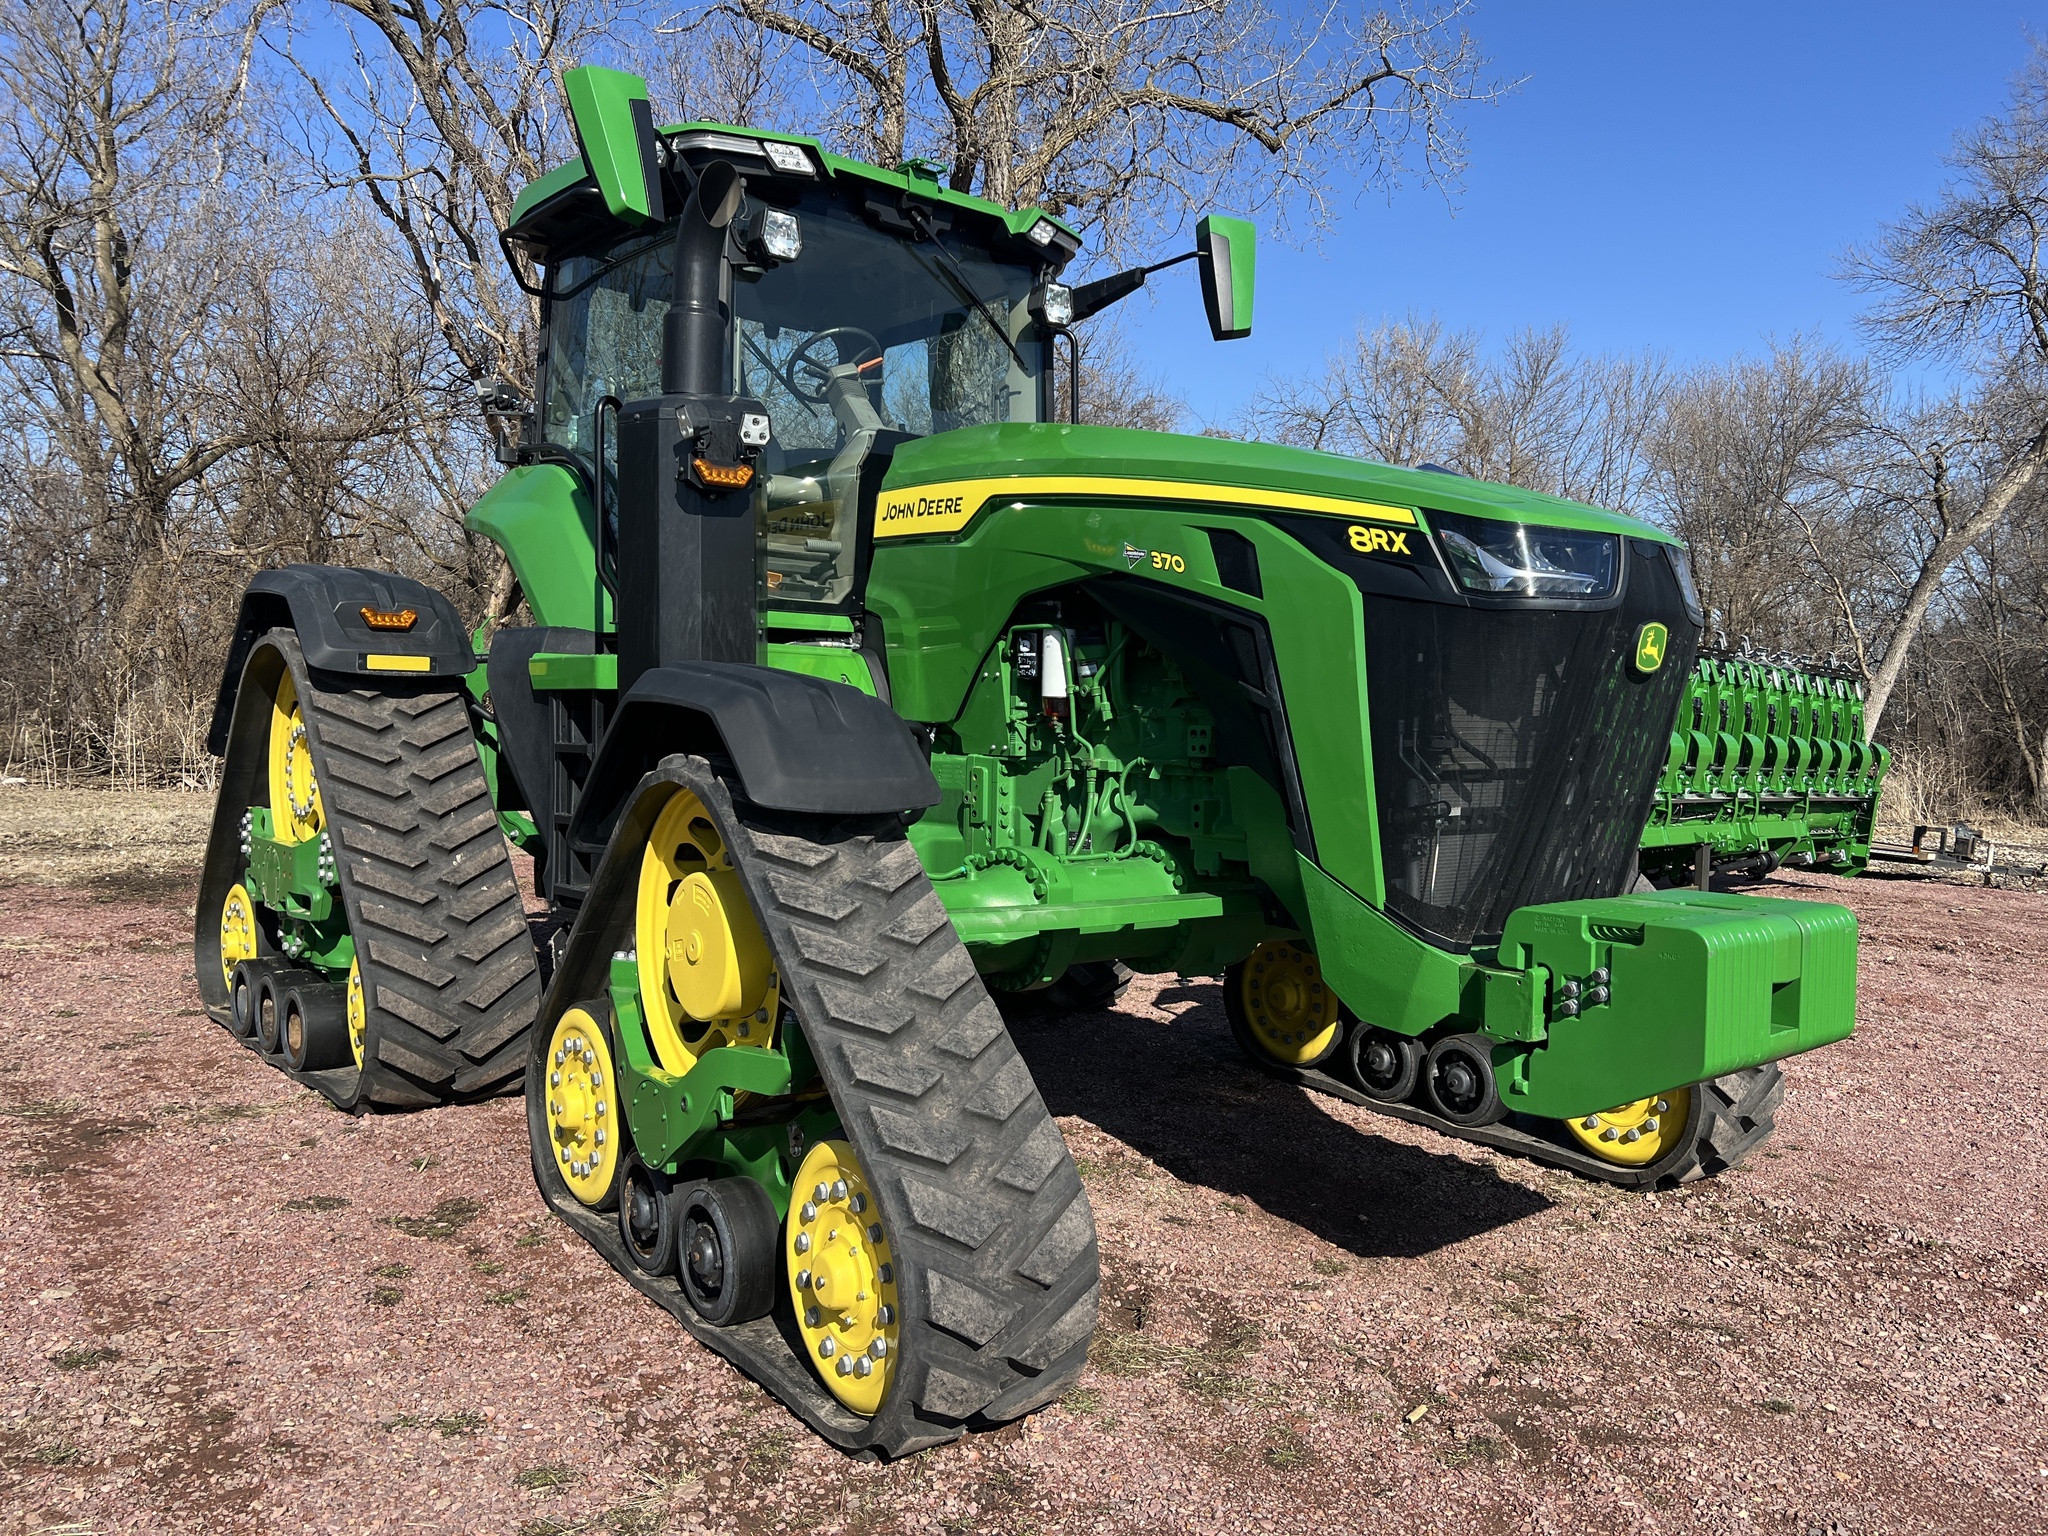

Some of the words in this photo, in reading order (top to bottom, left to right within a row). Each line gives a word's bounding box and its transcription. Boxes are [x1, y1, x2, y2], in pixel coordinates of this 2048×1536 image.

[882, 502, 915, 521] JOHN
[917, 496, 963, 517] DEERE
[1348, 525, 1412, 555] 8RX
[1150, 550, 1185, 573] 370
[1966, 863, 1991, 872] CAM
